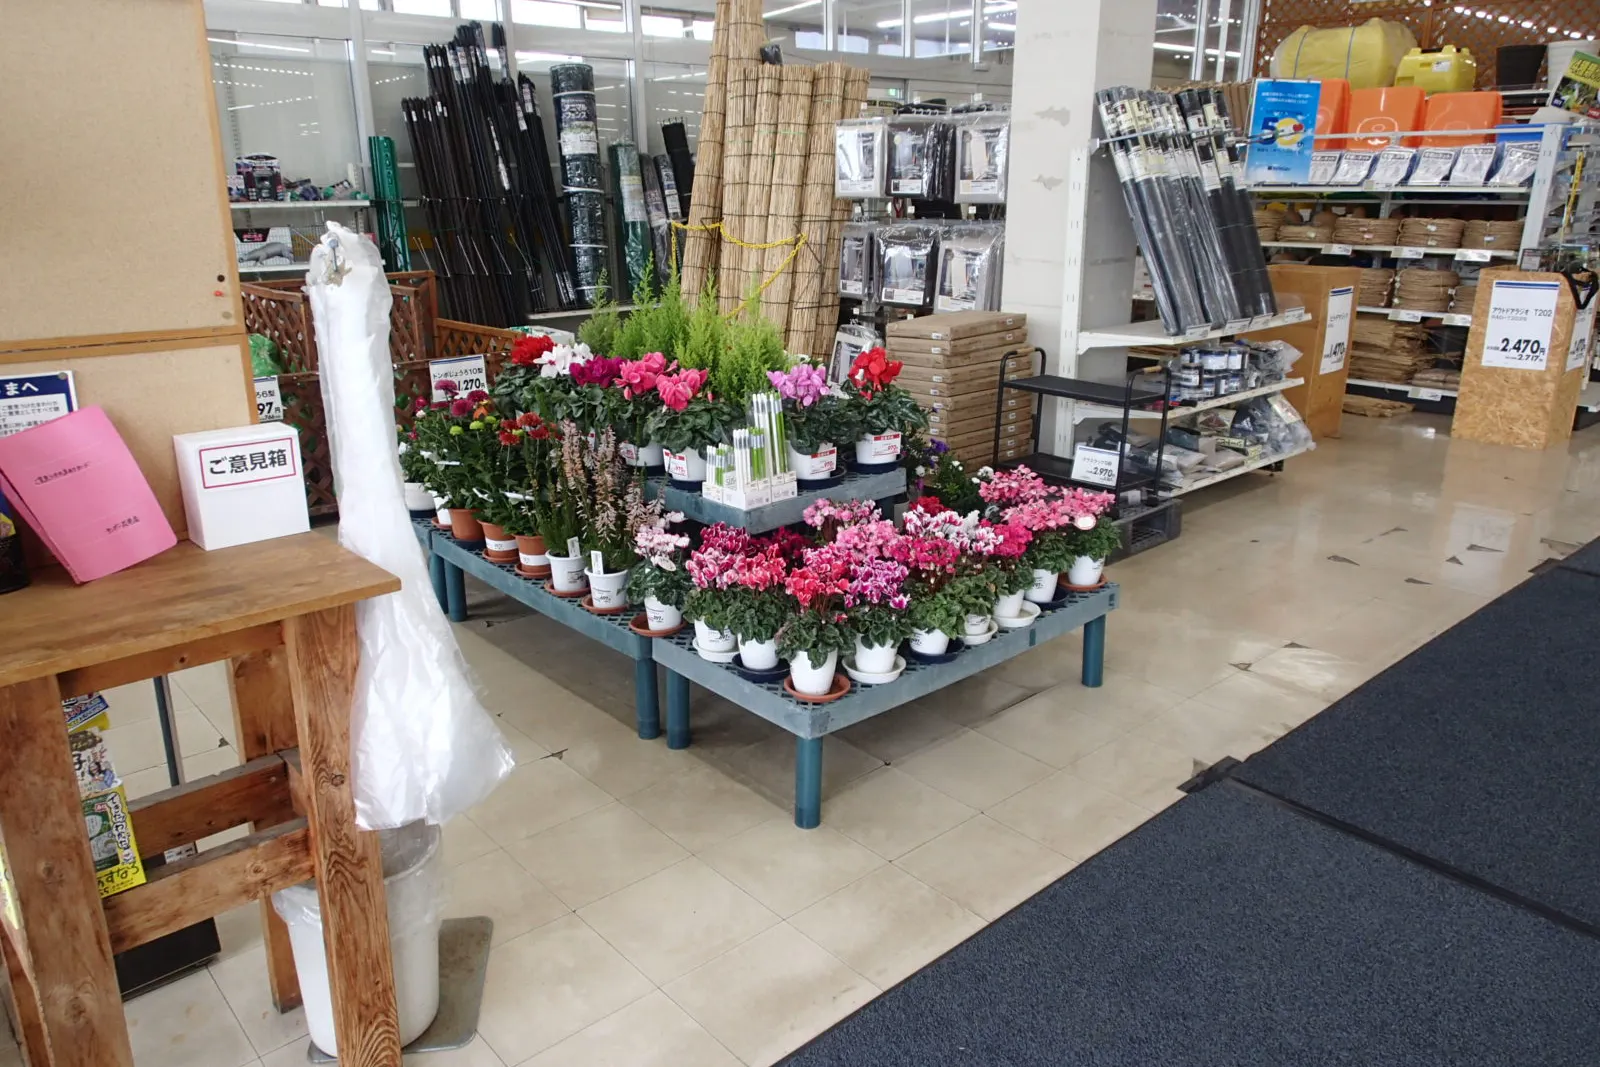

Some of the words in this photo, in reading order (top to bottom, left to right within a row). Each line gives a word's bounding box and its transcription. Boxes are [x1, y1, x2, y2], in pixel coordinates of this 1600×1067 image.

[1492, 307, 1529, 316] アウトドアラジオ
[1534, 309, 1552, 317] T202
[1500, 337, 1546, 356] 2,470円
[433, 367, 484, 379] トンボじょうろ10型
[0, 382, 39, 396] まへ
[209, 448, 287, 474] ご意見箱
